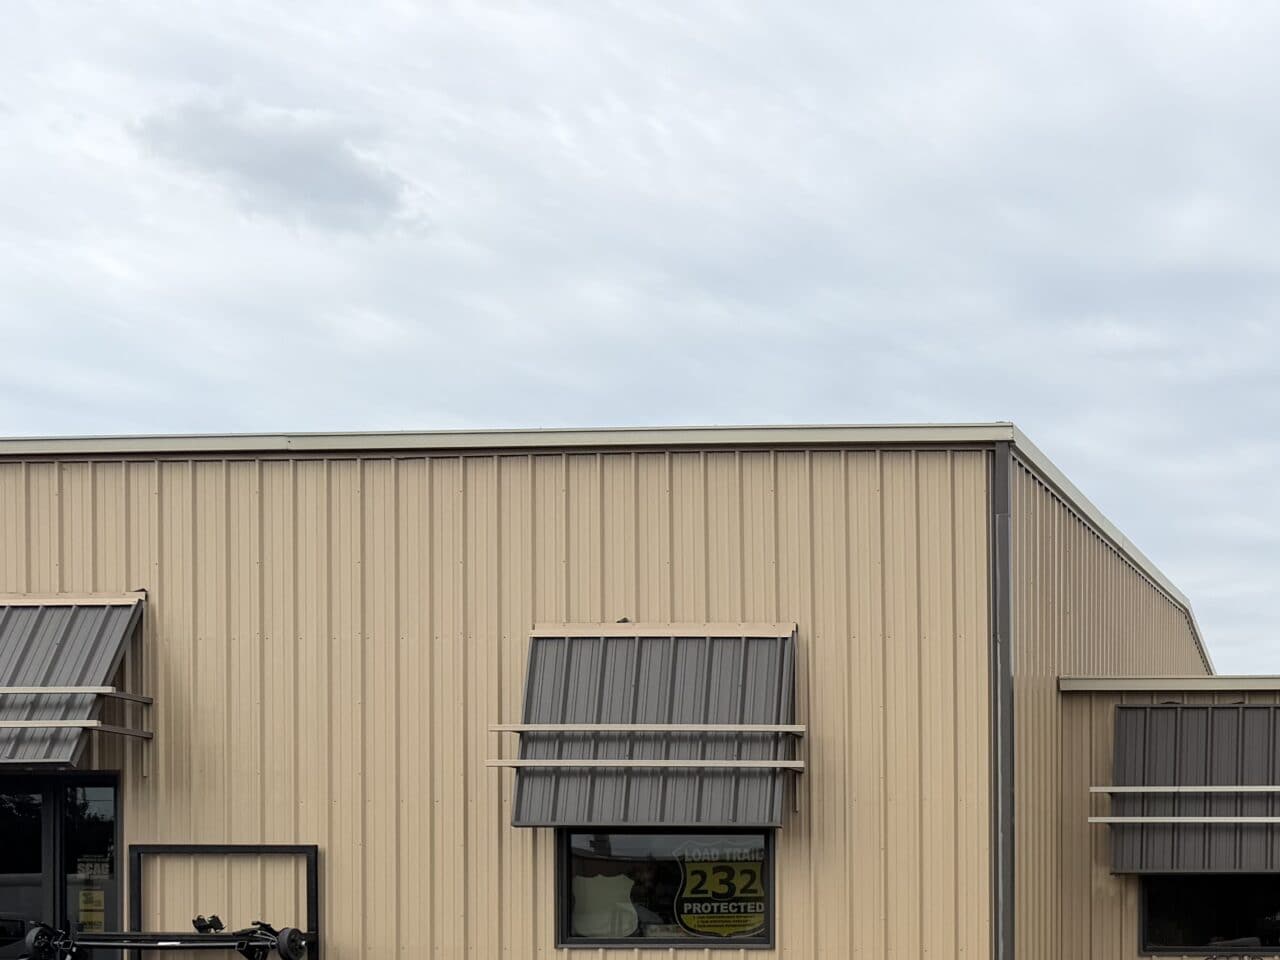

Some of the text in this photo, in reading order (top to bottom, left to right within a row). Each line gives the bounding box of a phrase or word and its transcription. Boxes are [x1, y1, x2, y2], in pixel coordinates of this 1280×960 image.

[684, 847, 720, 862] LOAD
[690, 865, 759, 899] 232
[683, 902, 765, 914] PROTECTED
